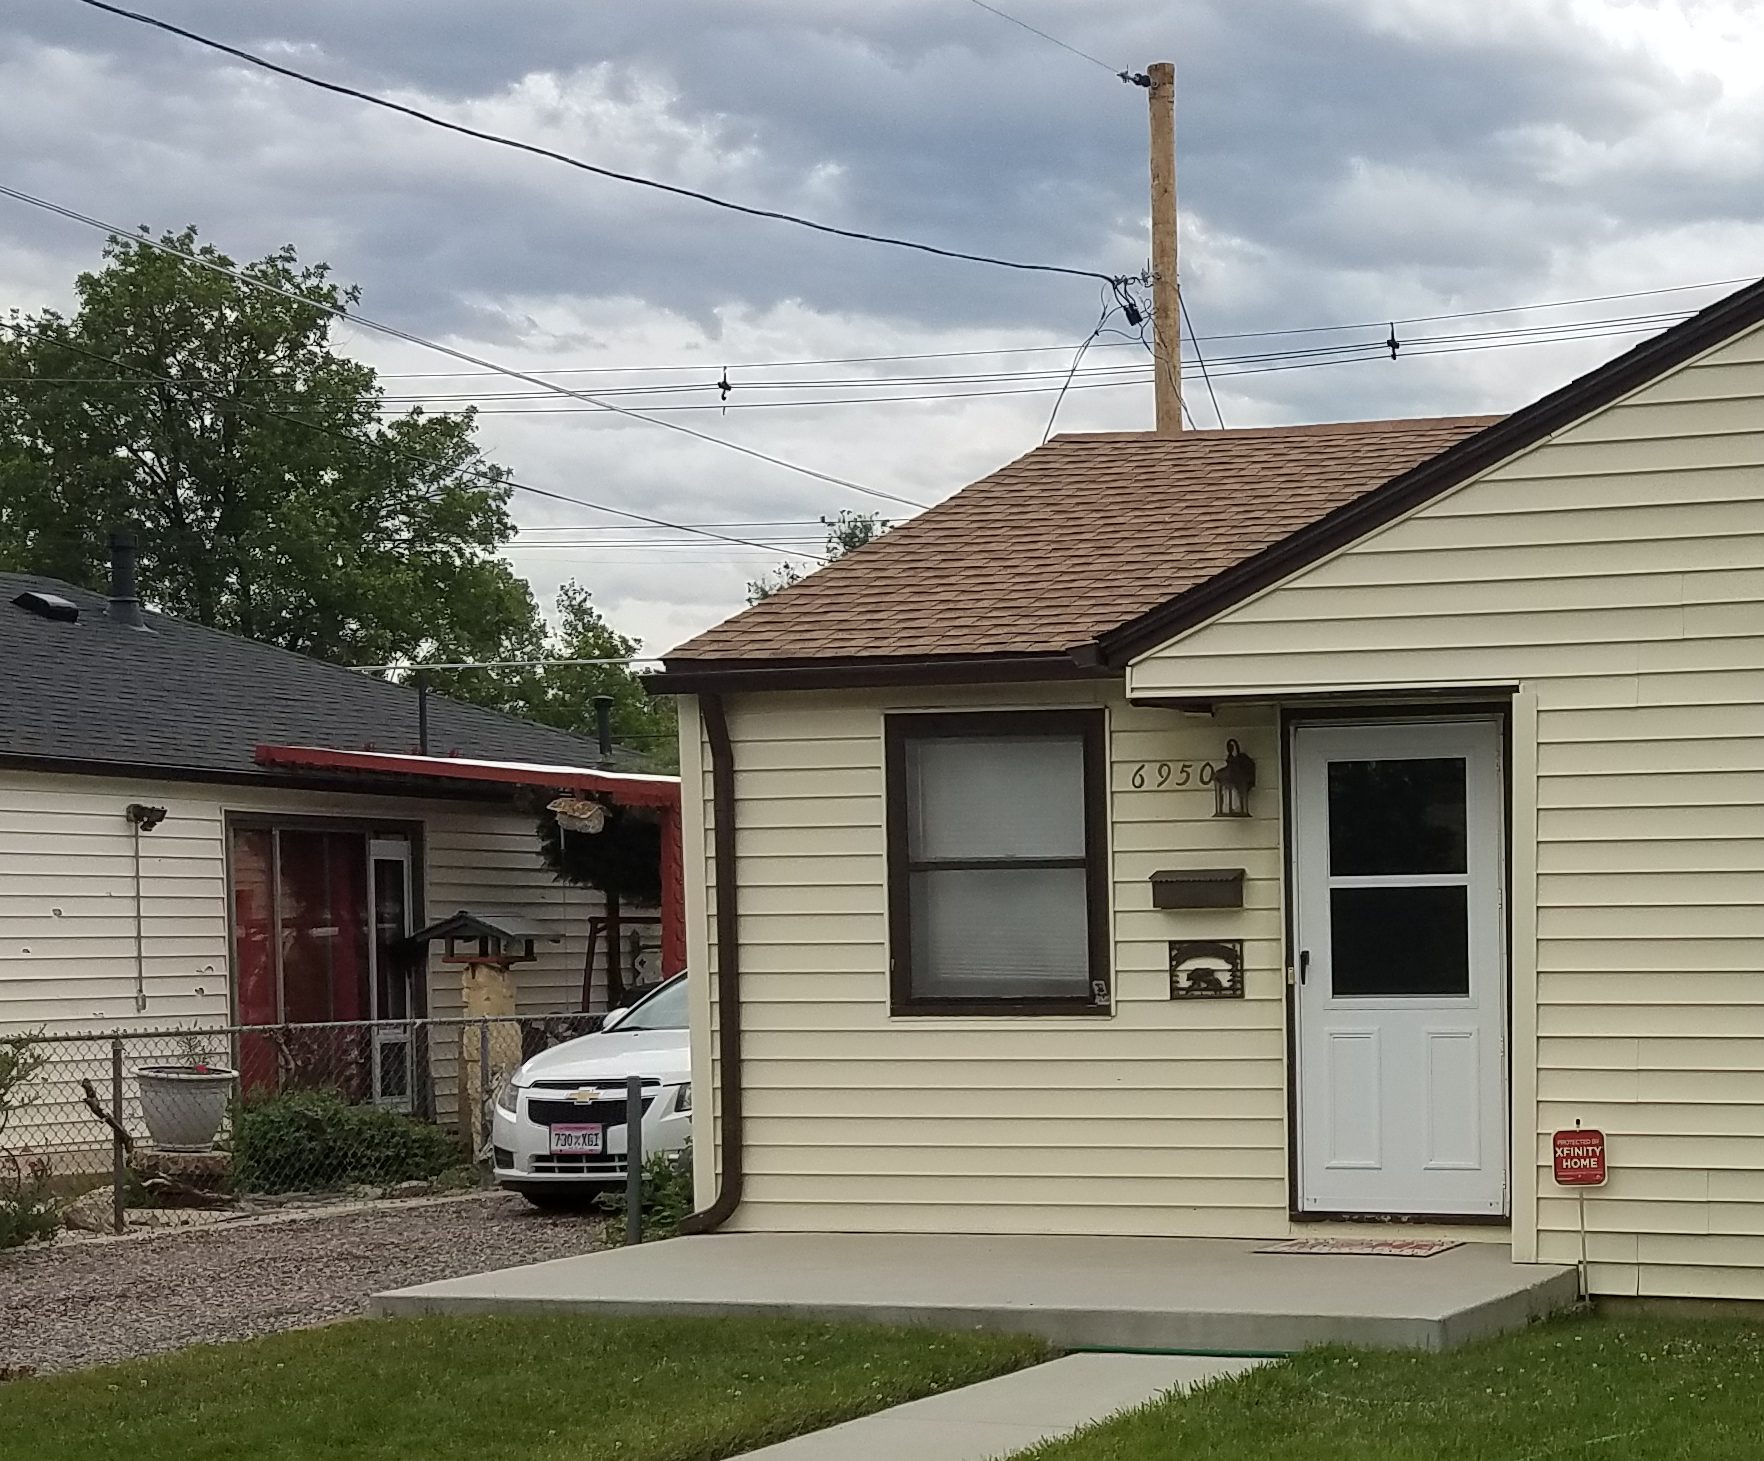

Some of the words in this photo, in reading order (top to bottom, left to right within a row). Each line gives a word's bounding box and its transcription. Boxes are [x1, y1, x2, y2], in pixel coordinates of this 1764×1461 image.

[1131, 762, 1216, 788] 6950
[1555, 1146, 1602, 1157] XFINITY
[1562, 1158, 1598, 1168] HOME
